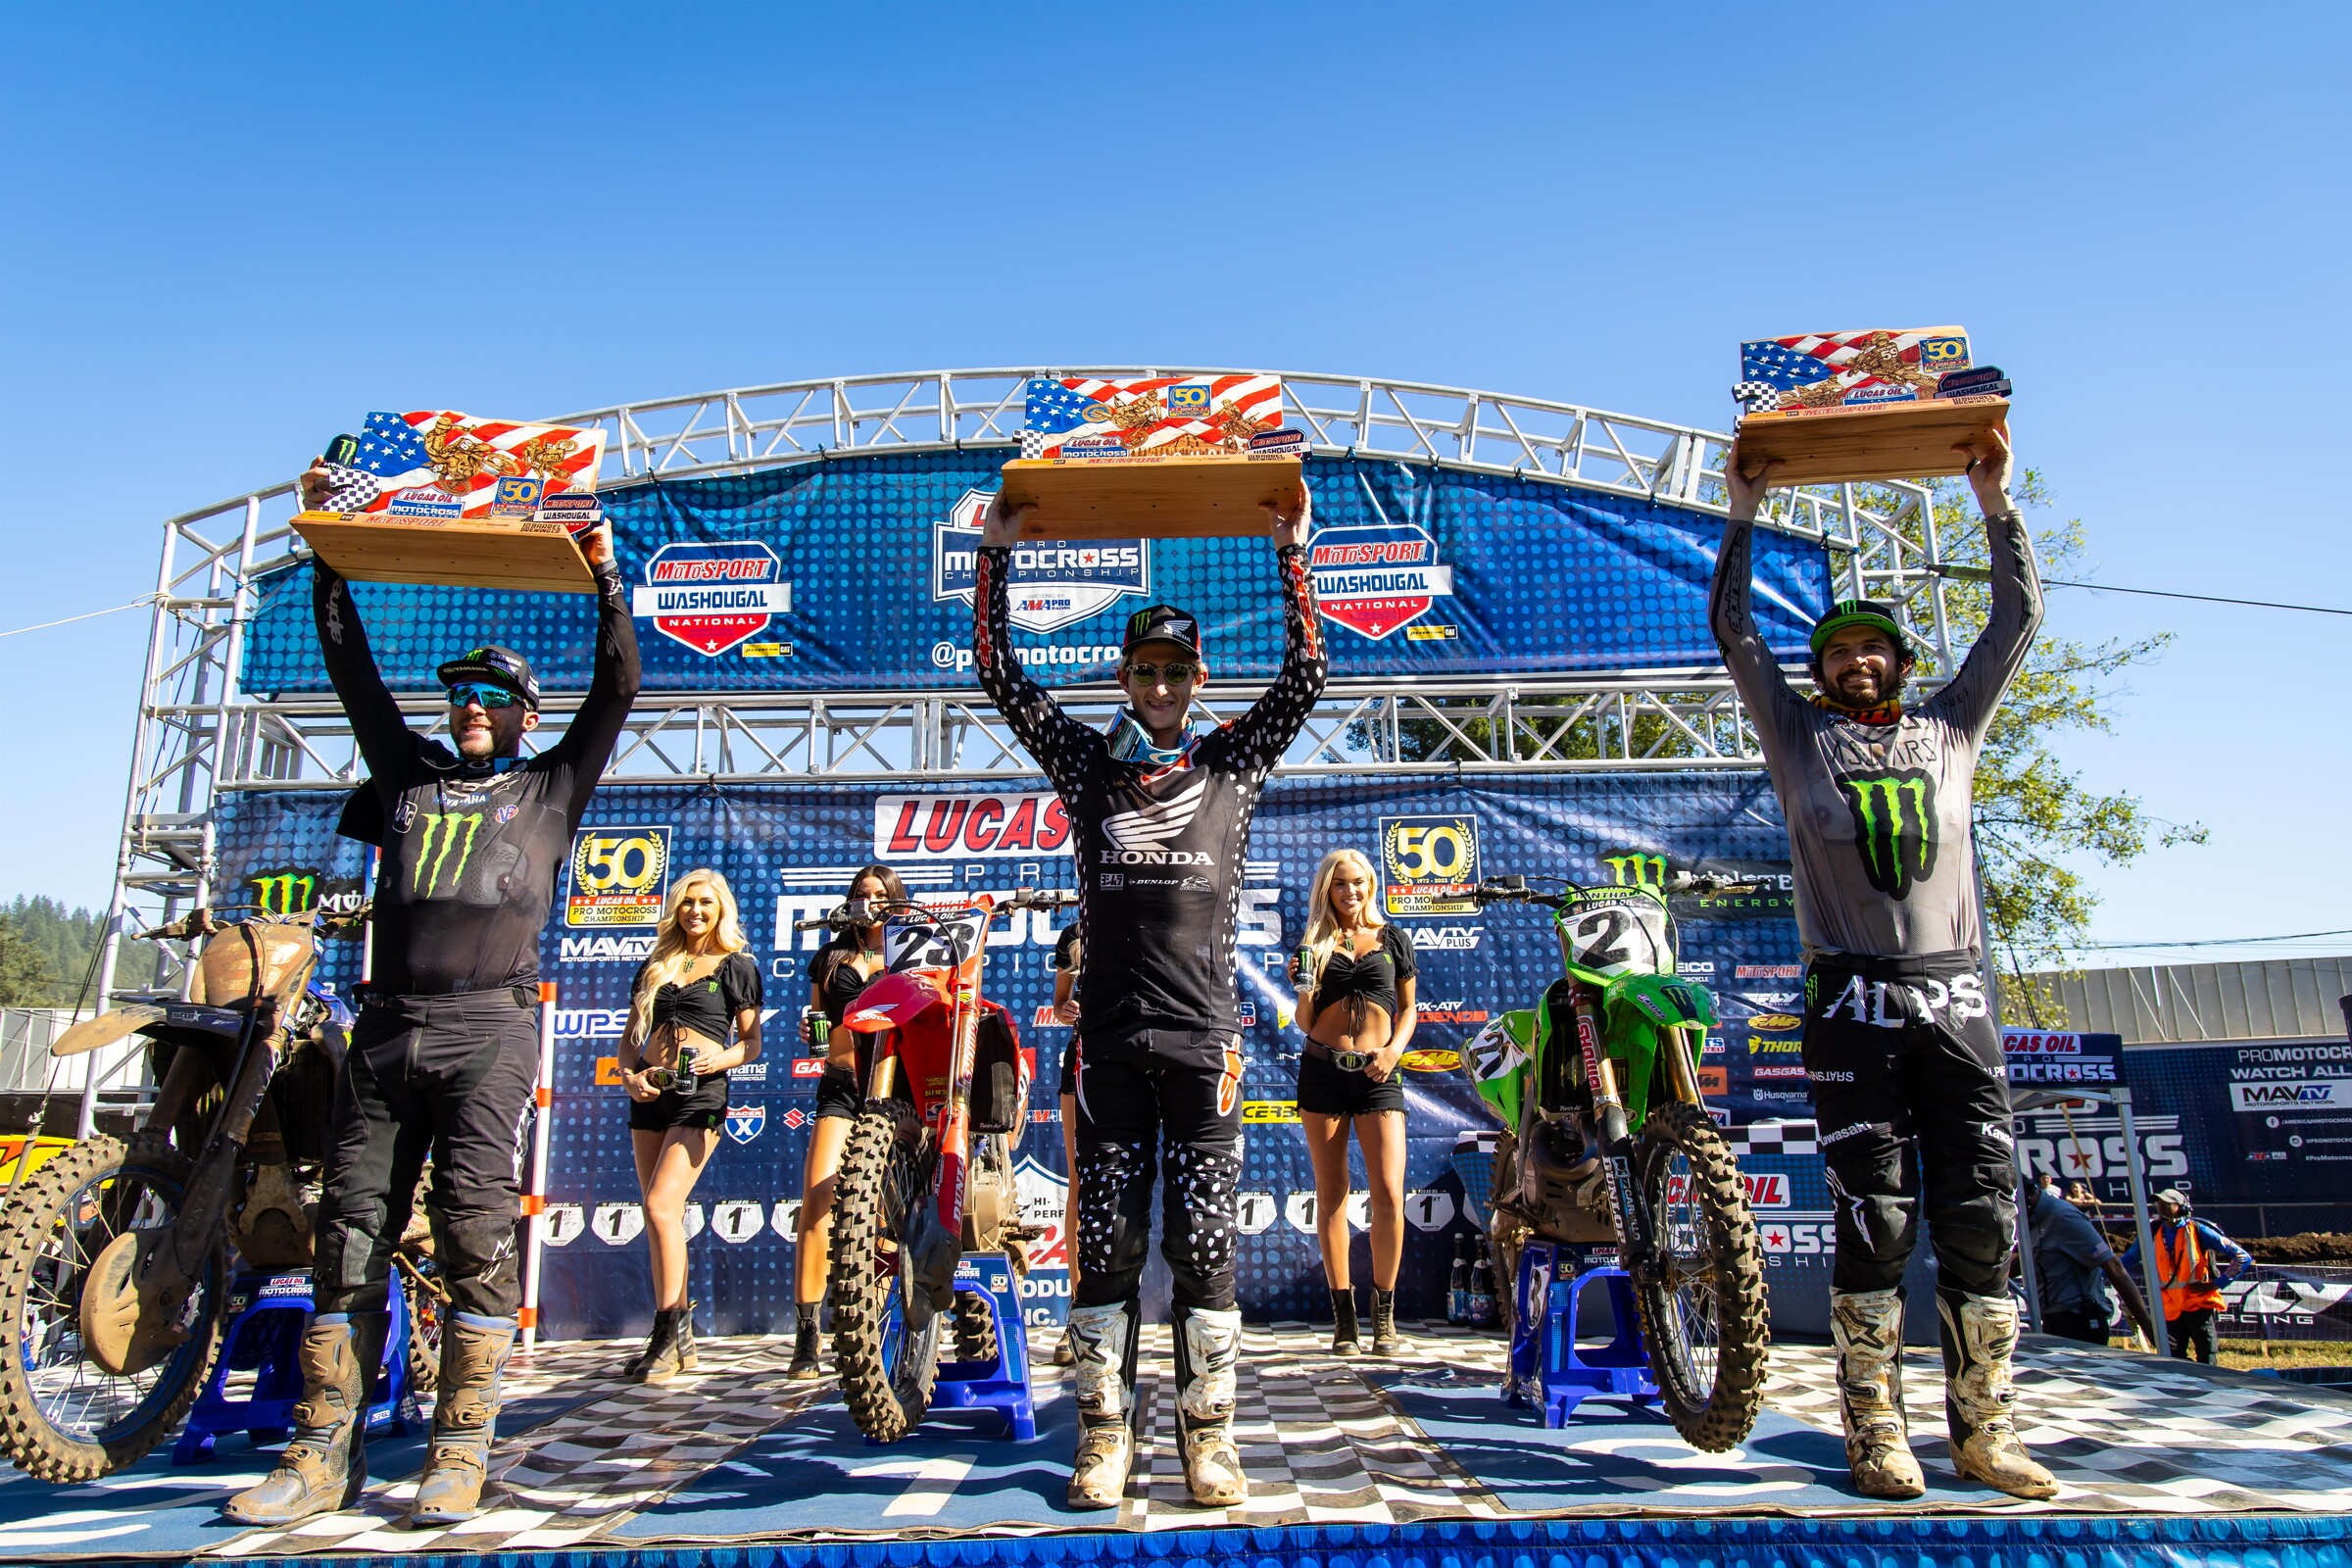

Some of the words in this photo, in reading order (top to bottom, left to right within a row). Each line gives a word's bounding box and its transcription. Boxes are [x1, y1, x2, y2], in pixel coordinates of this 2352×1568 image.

[1881, 348, 1898, 360] 59
[1928, 341, 1962, 360] 50
[1175, 389, 1205, 406] 50
[1855, 389, 1886, 398] LUCAS
[404, 492, 436, 502] LUCAS
[439, 494, 454, 504] OIL
[503, 481, 536, 501] 50
[391, 505, 460, 517] MOTOCROSS
[543, 511, 591, 520] WASHOUGAL
[945, 548, 1139, 570] MOCROSS
[945, 568, 1139, 579] CHPIONSHIP
[1317, 573, 1428, 594] WASHOUGAL
[658, 590, 767, 610] WASHOUGAL
[1014, 600, 1051, 611] AMA
[1332, 601, 1418, 611] NATIONAL
[669, 617, 757, 626] NATIONAL
[887, 798, 1072, 853] LUCAS
[1100, 851, 1214, 865] HONDA
[1396, 826, 1467, 879] 50
[584, 838, 658, 889] 50
[1411, 886, 1440, 895] LUCAS
[595, 897, 622, 906] LUCAS
[623, 897, 637, 906] OIL
[1392, 896, 1411, 905] PRO
[1587, 901, 1617, 910] LUCAS
[1700, 899, 1794, 907] ENERGY
[1578, 910, 1660, 969] 21
[888, 923, 975, 973] 23
[1677, 961, 1715, 973] EICO
[1822, 974, 1987, 1028] ALPS
[2004, 1036, 2041, 1052] CAS
[2045, 1036, 2077, 1052] OIL
[2238, 1046, 2352, 1063] PROMOTOCR
[1755, 1067, 1805, 1076] GASGAS
[2009, 1064, 2117, 1080] OCROSS
[2230, 1066, 2306, 1079] WATCH
[2313, 1065, 2352, 1077] ALL
[1764, 1090, 1808, 1101] Husqvarna
[734, 1118, 755, 1136] X
